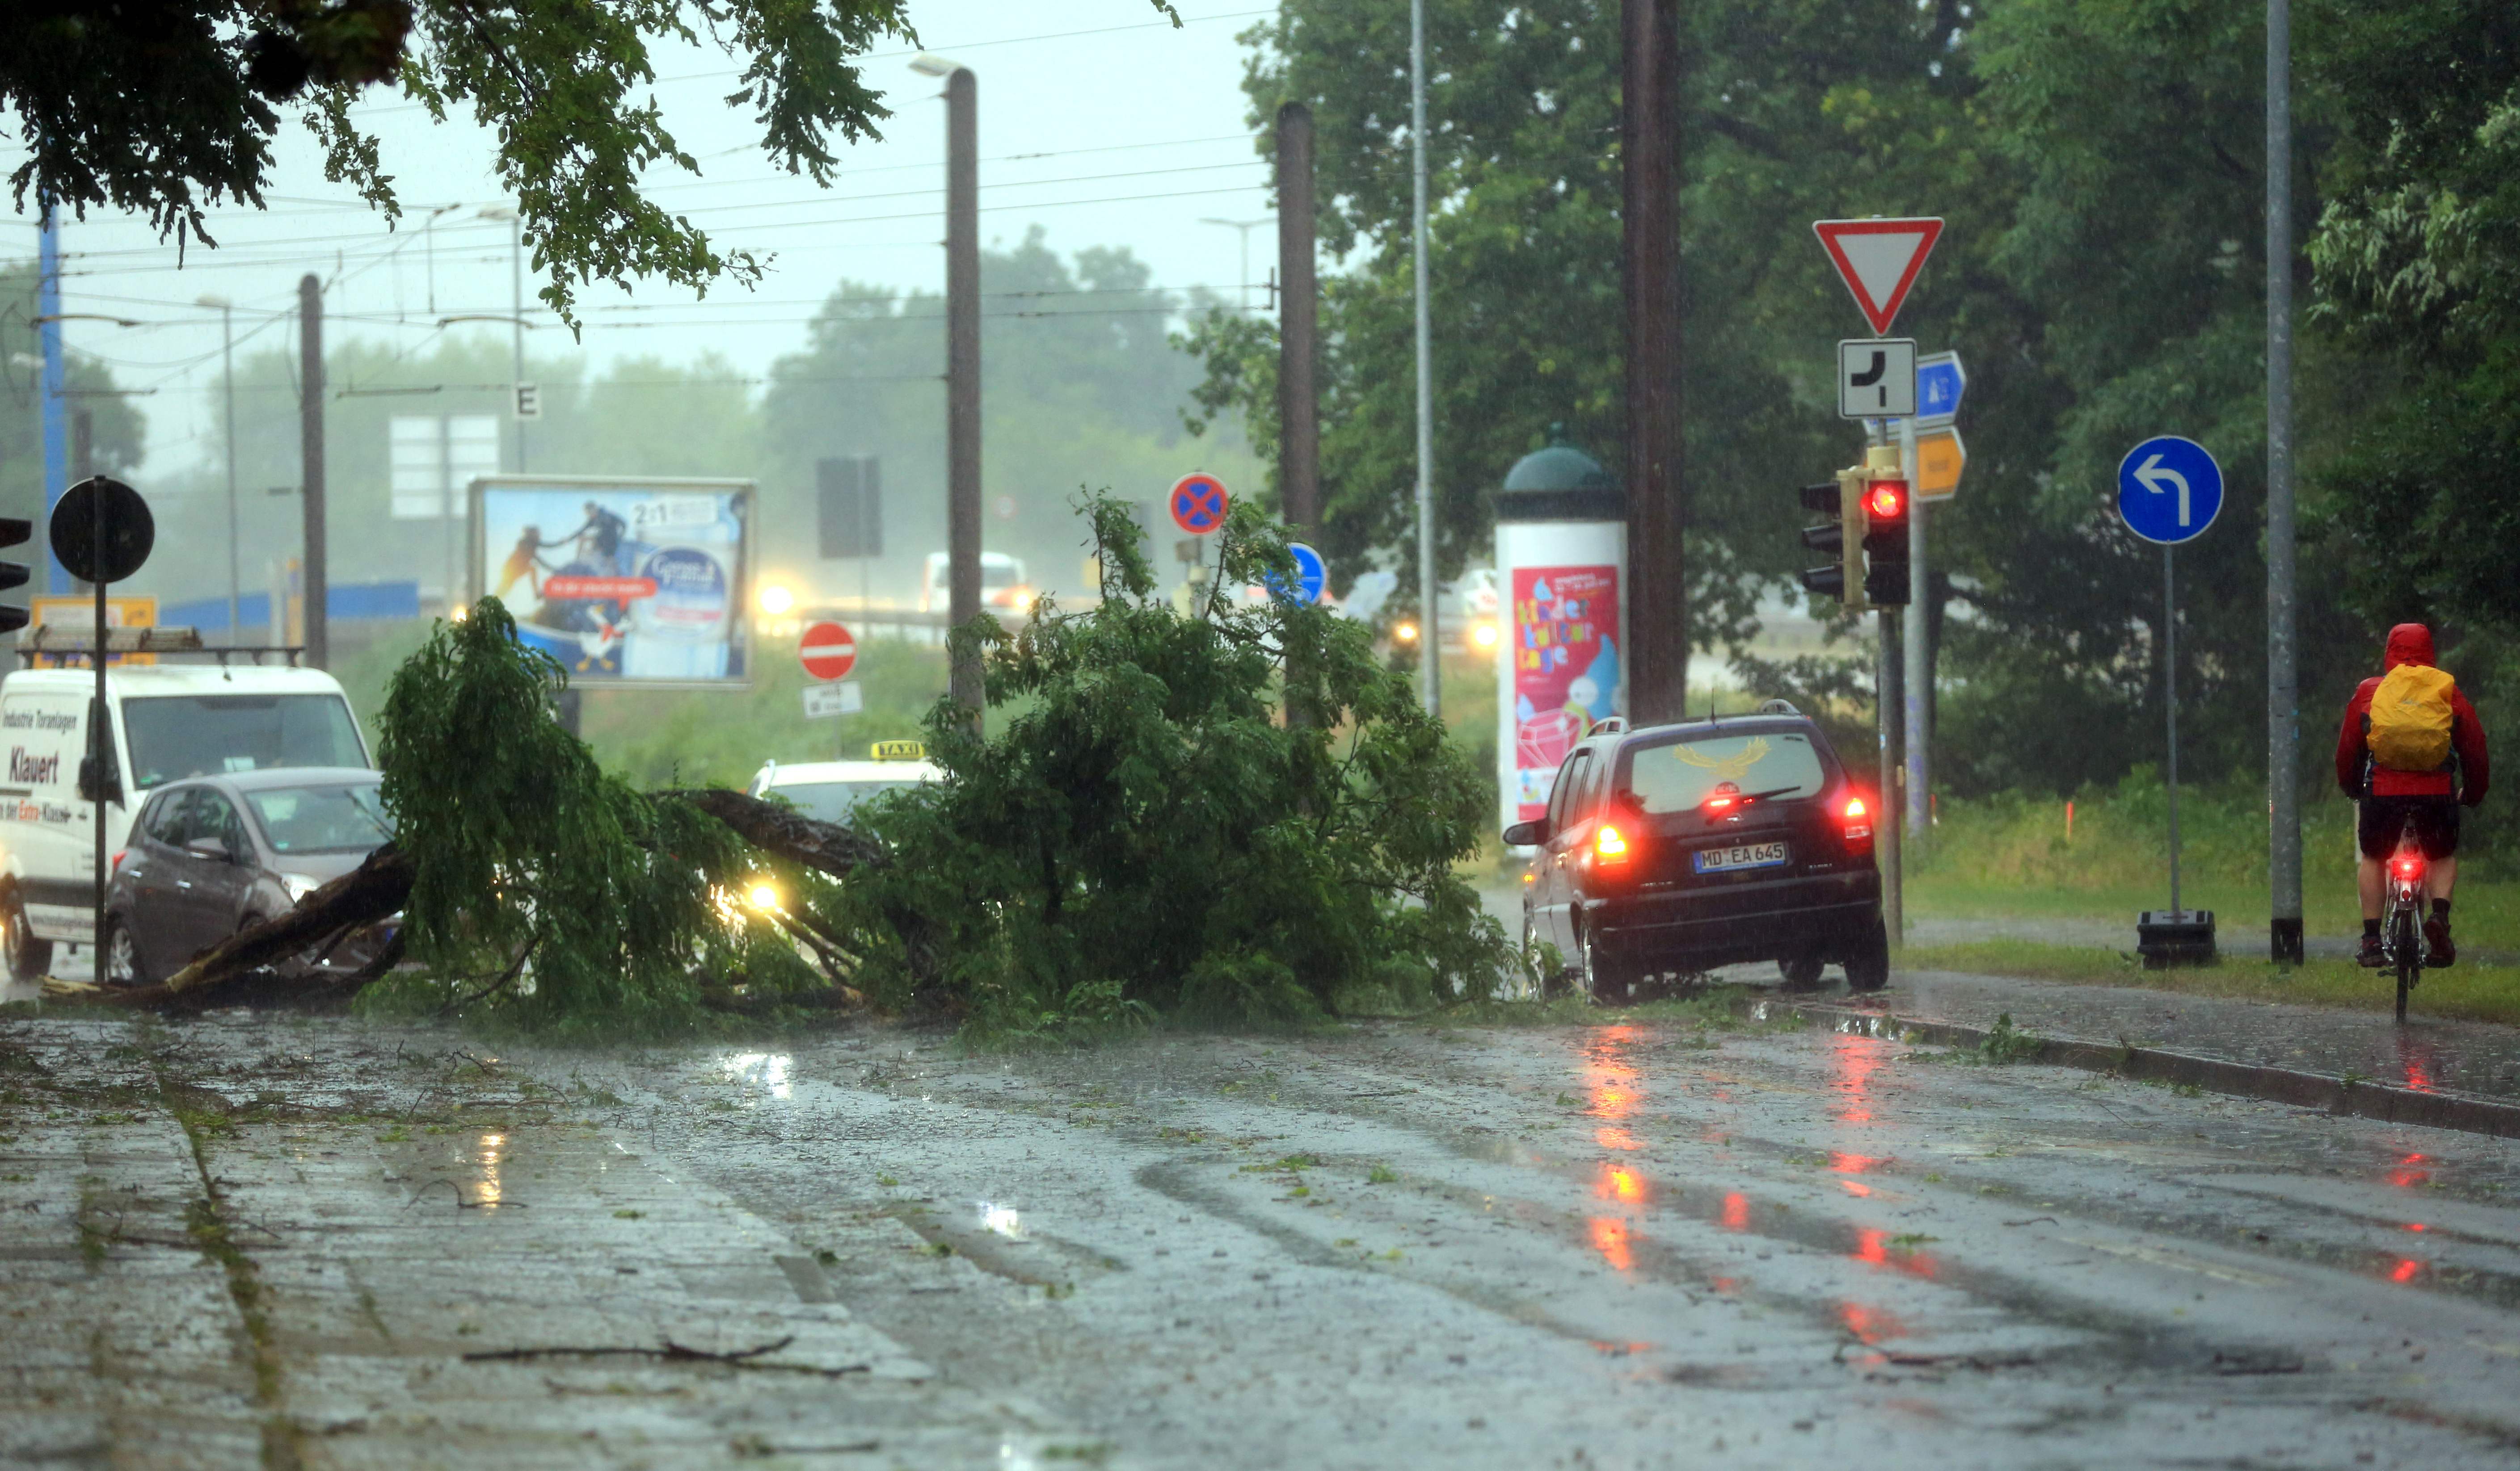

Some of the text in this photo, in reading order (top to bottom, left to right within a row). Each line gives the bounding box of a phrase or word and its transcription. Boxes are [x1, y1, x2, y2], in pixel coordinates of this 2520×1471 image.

[518, 386, 537, 415] E
[36, 708, 77, 735] Toranlagen
[882, 743, 916, 755] TAXI
[9, 747, 59, 784] Klauert
[1702, 844, 1783, 866] MD EA 645
